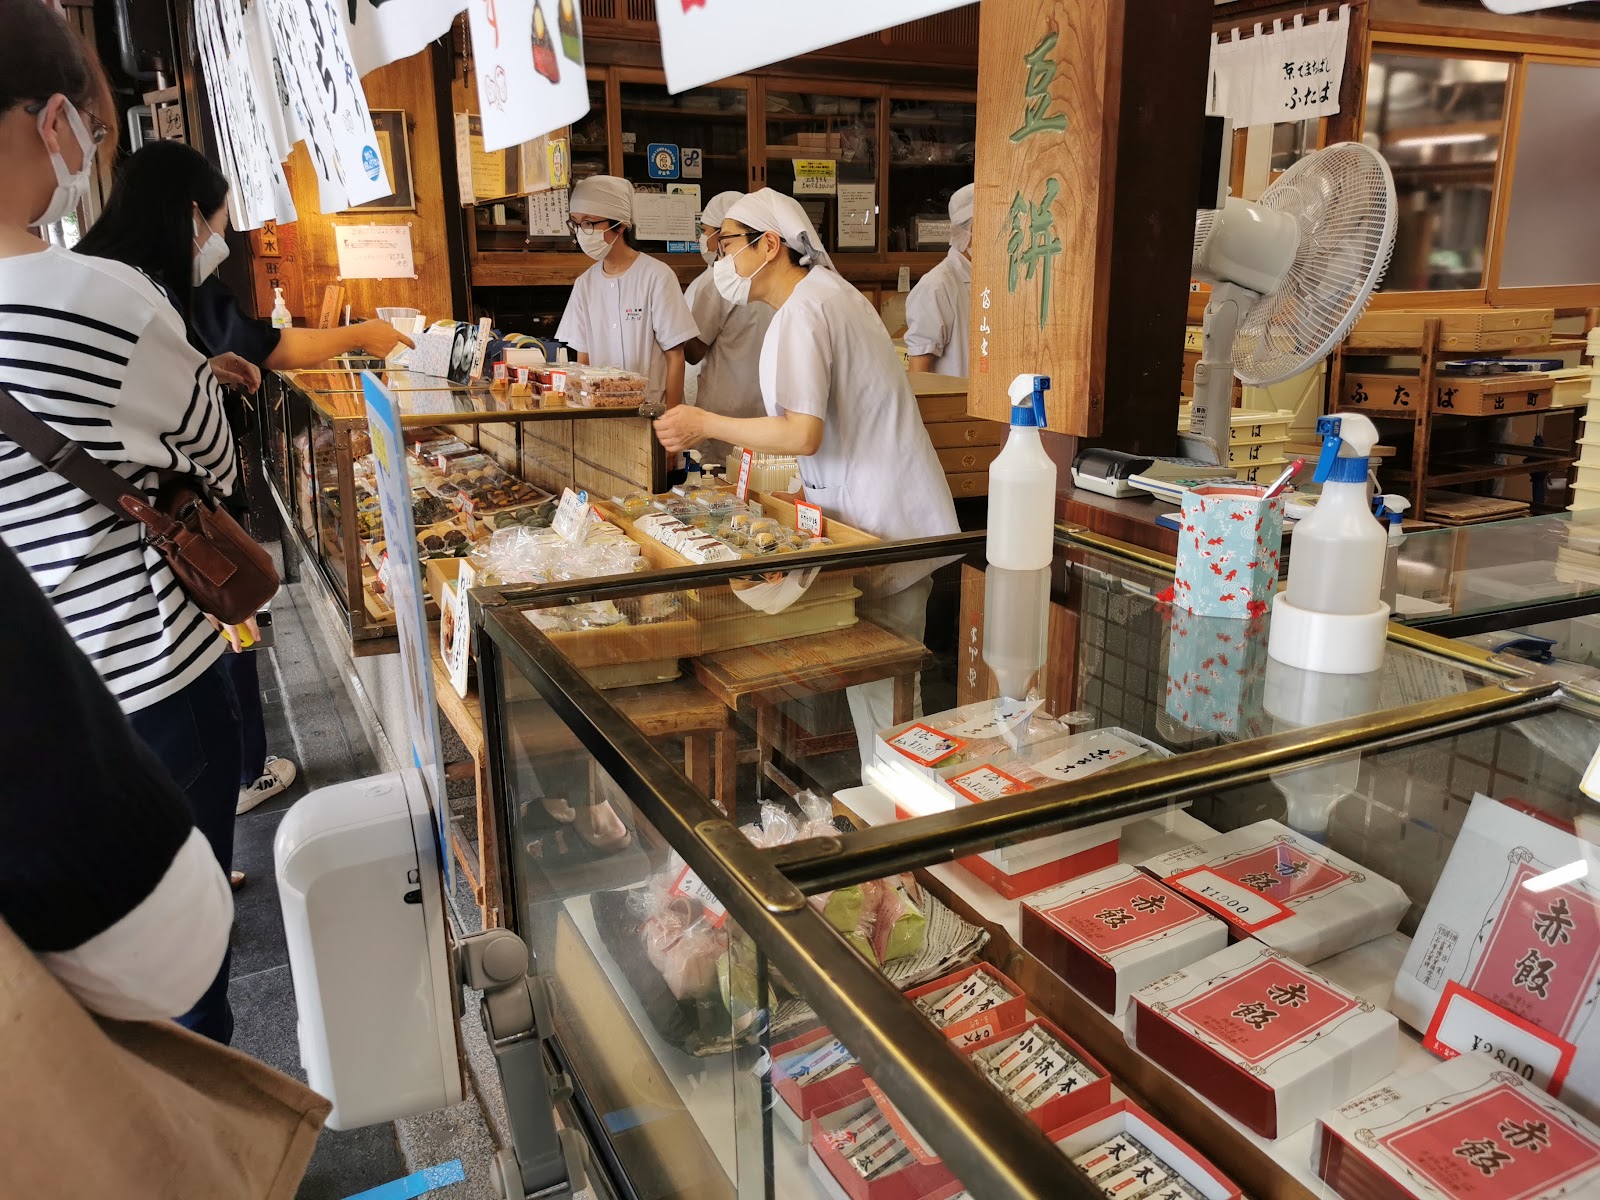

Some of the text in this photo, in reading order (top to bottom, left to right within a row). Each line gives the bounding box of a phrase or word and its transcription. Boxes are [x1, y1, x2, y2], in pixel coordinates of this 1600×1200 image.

[1285, 81, 1333, 110] ふたば
[1007, 31, 1068, 332] 豆餅
[264, 224, 275, 236] 火
[264, 240, 276, 252] 水
[1351, 383, 1459, 409] ふたば
[1494, 392, 1539, 410] 出町
[1238, 861, 1310, 893] 赤飯
[1094, 894, 1167, 930] 赤飯
[1199, 885, 1250, 914] ¥1900
[1512, 898, 1576, 1000] 赤飯
[1231, 982, 1309, 1030] 赤飯
[1104, 1142, 1127, 1162] 本
[1453, 1117, 1552, 1177] 赤飯
[1132, 1165, 1155, 1185] 本
